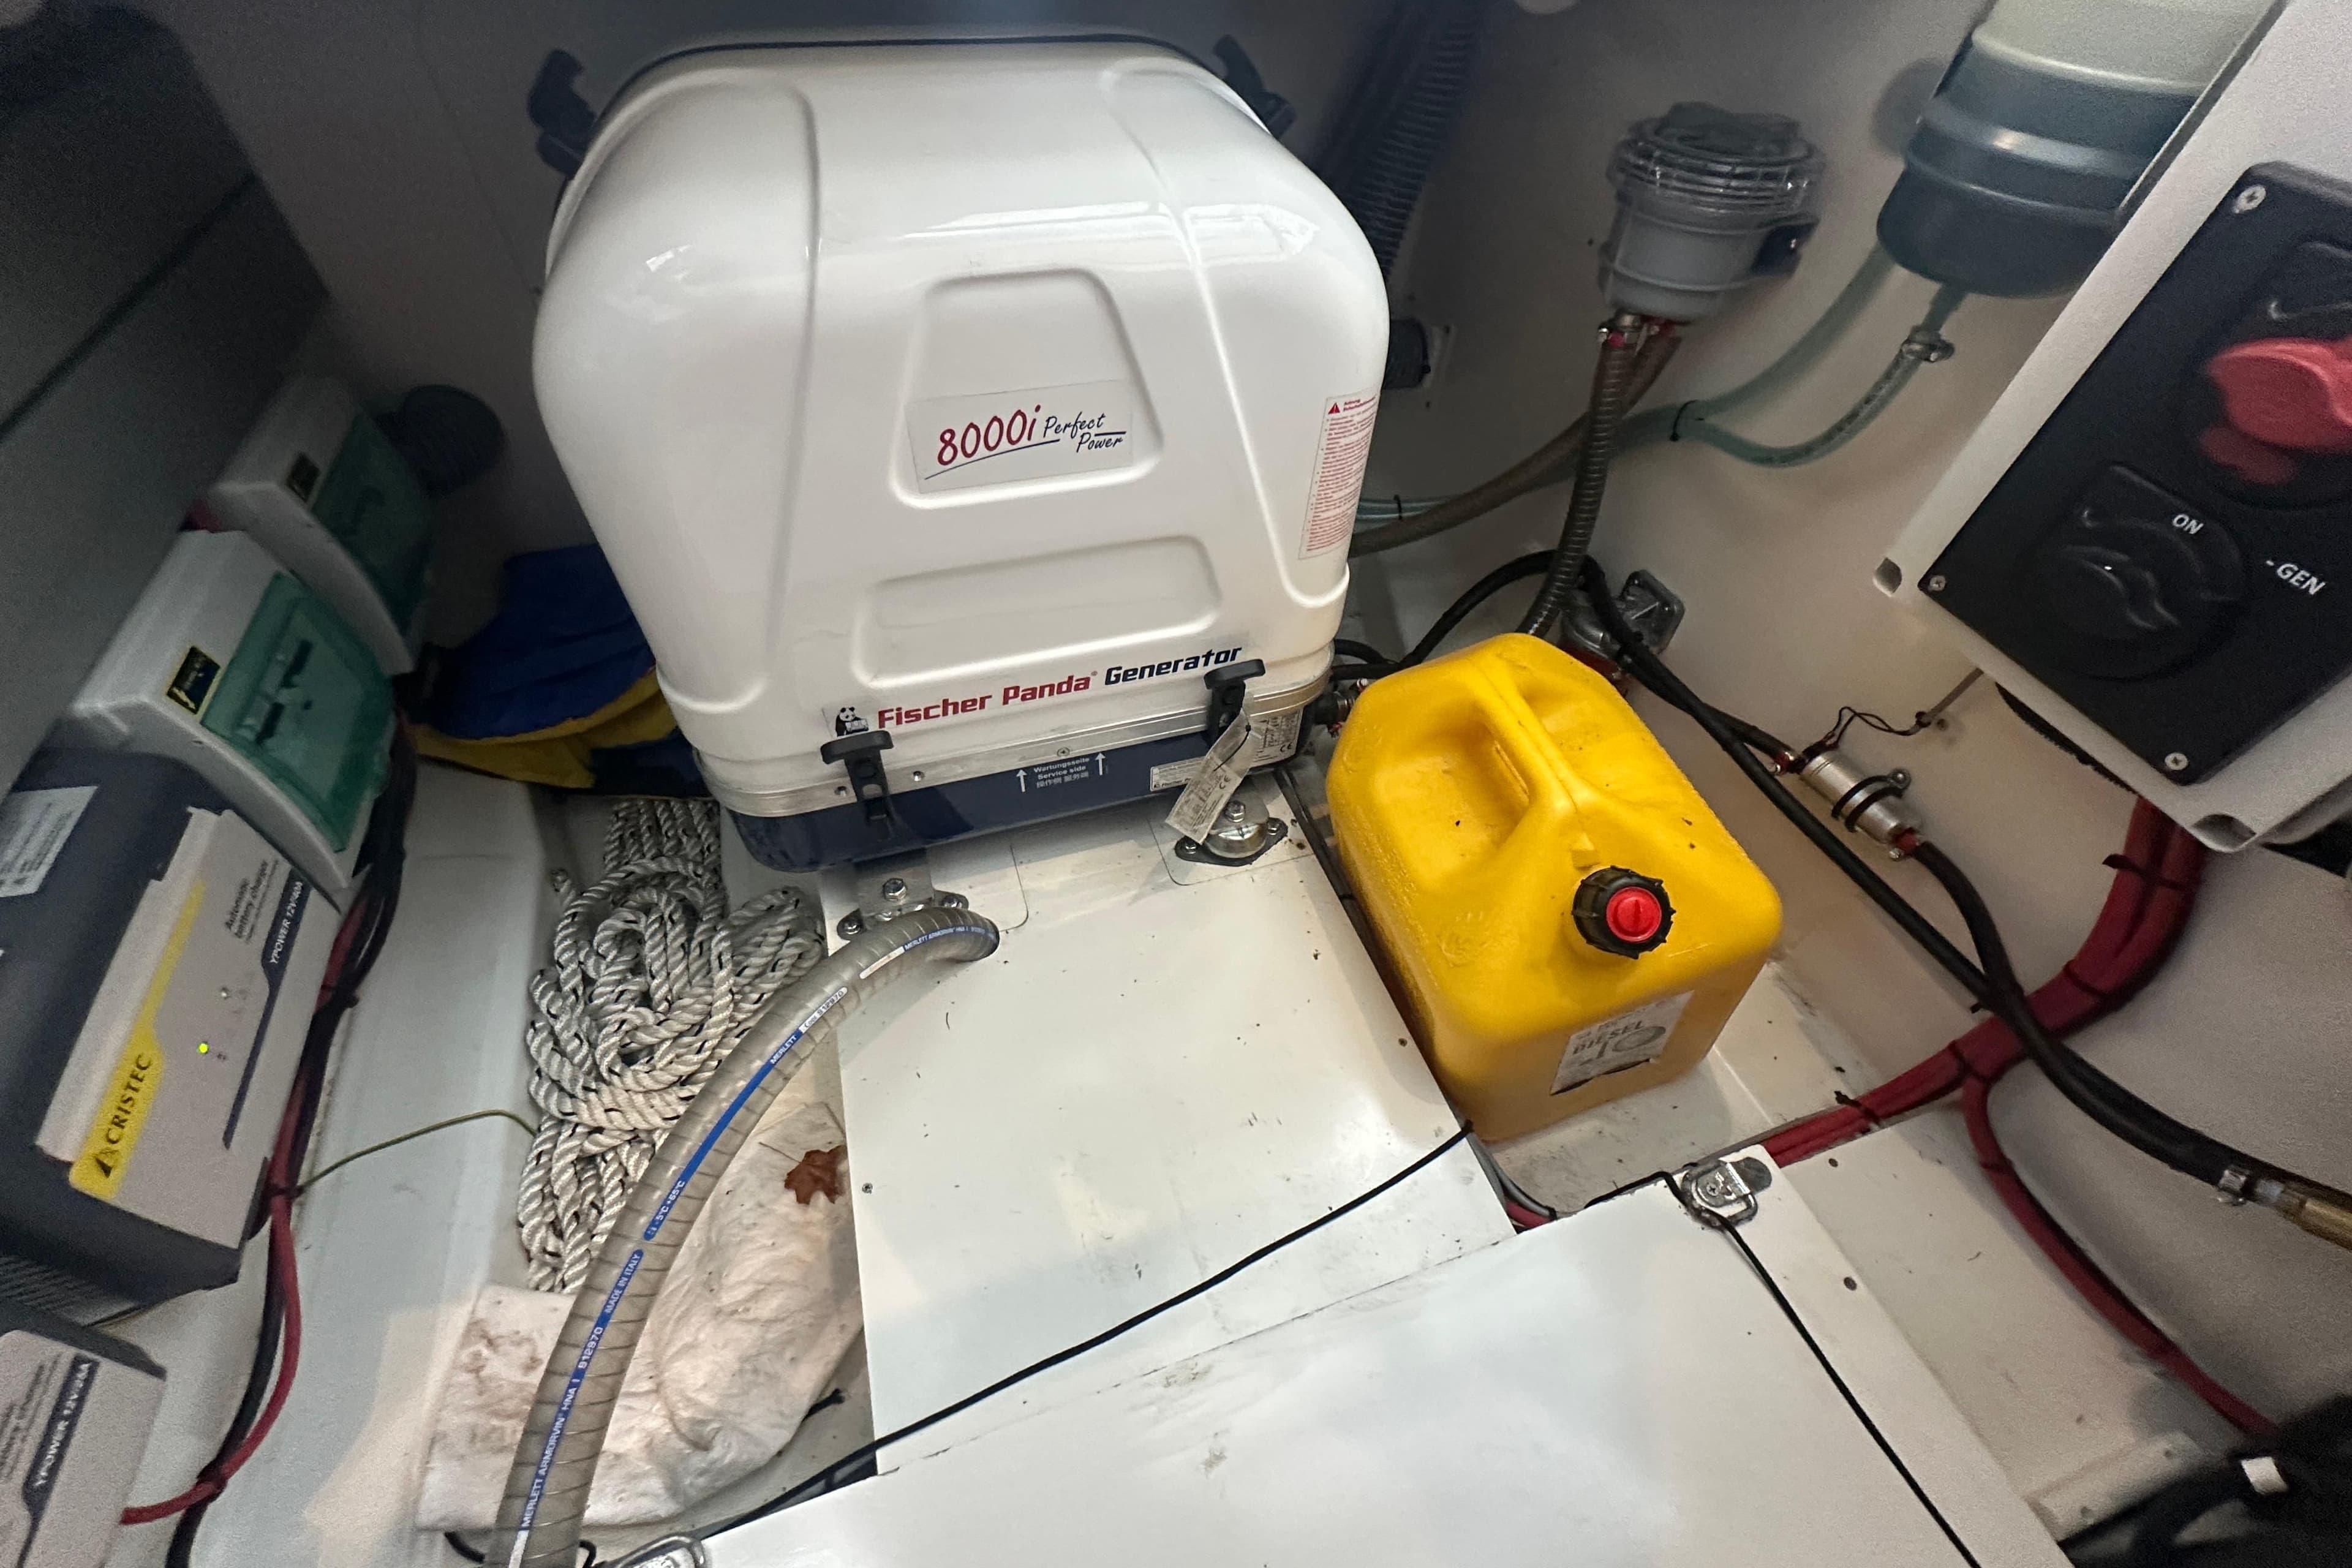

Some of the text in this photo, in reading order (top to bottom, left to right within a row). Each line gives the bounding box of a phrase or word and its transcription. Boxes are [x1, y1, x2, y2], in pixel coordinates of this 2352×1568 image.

[938, 404, 1106, 466] 8000i Perfect
[1076, 432, 1124, 453] Power
[2172, 514, 2204, 535] ON
[878, 695, 993, 729] Fischer
[1104, 647, 1242, 685] Generator
[1038, 765, 1087, 780] Service side
[270, 919, 291, 963] YPOWER
[770, 1035, 797, 1065] MERLETT
[106, 1053, 152, 1145] CRISTEC
[604, 1254, 641, 1314] MADE IN ITALY
[521, 1479, 543, 1527] MERLETT
[562, 1387, 577, 1410] HNA
